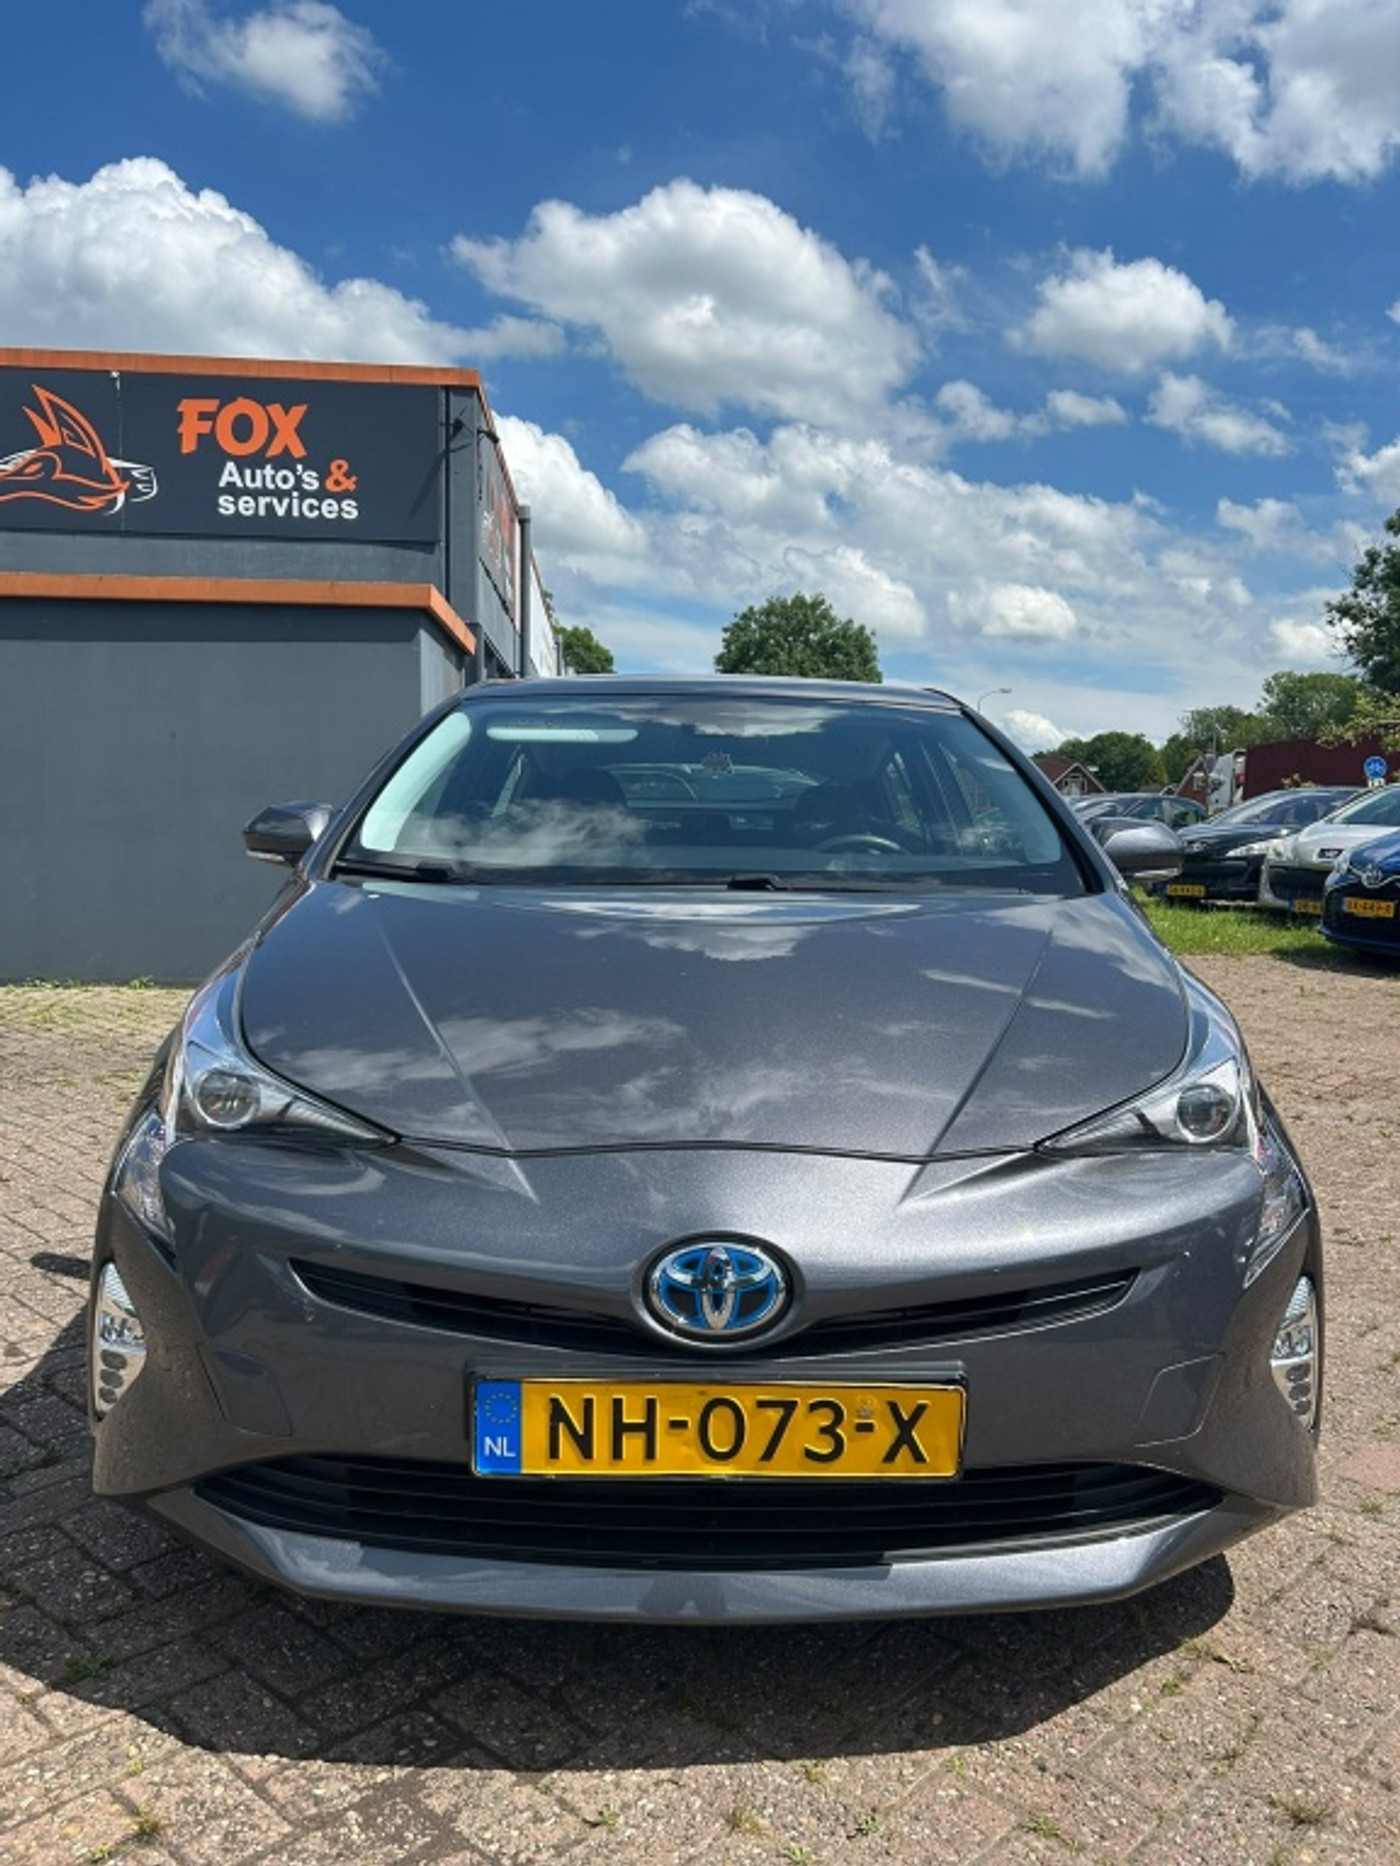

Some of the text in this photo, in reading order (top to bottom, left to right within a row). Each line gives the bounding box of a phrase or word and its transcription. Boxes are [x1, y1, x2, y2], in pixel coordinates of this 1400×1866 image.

[177, 397, 308, 458] FOX
[218, 459, 357, 492] Auto's &
[217, 491, 359, 520] services
[548, 1395, 930, 1465] NH-073-X
[484, 1437, 516, 1458] NL
